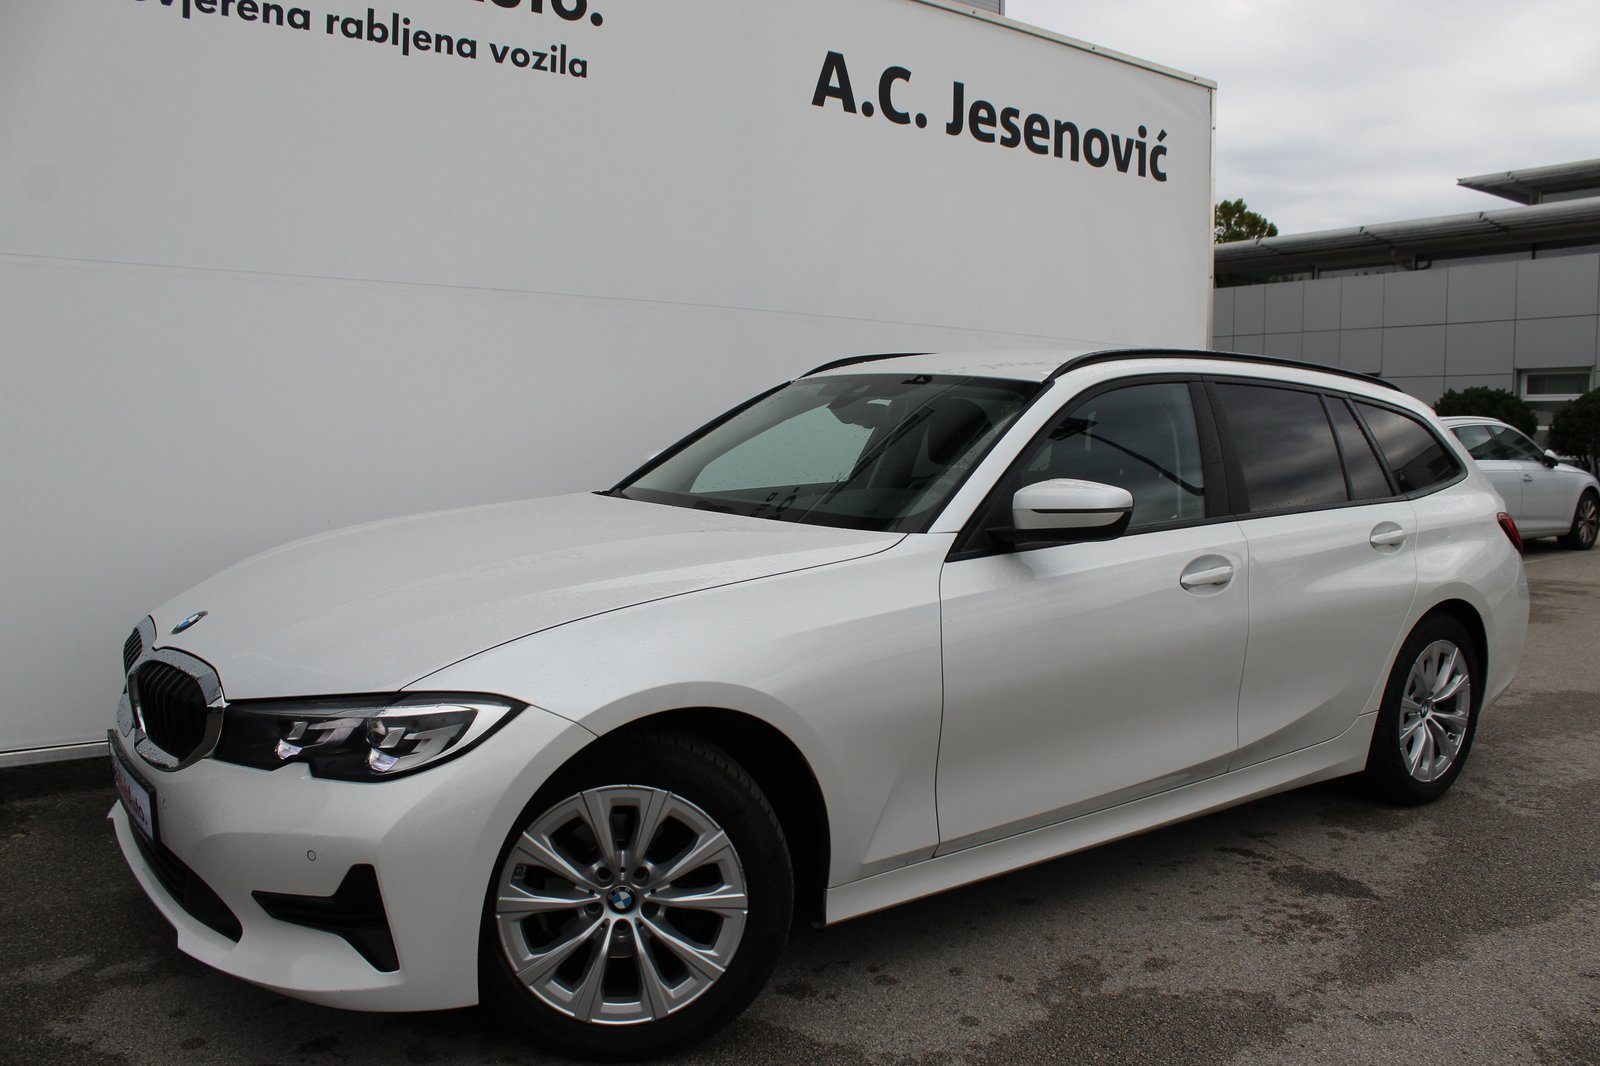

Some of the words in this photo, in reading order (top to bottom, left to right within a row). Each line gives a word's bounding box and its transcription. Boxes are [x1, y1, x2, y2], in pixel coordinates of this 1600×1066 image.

[326, 8, 477, 60] rabljena
[488, 43, 588, 79] vozila
[811, 50, 928, 130] A.C.
[945, 80, 1168, 183] Jesenović
